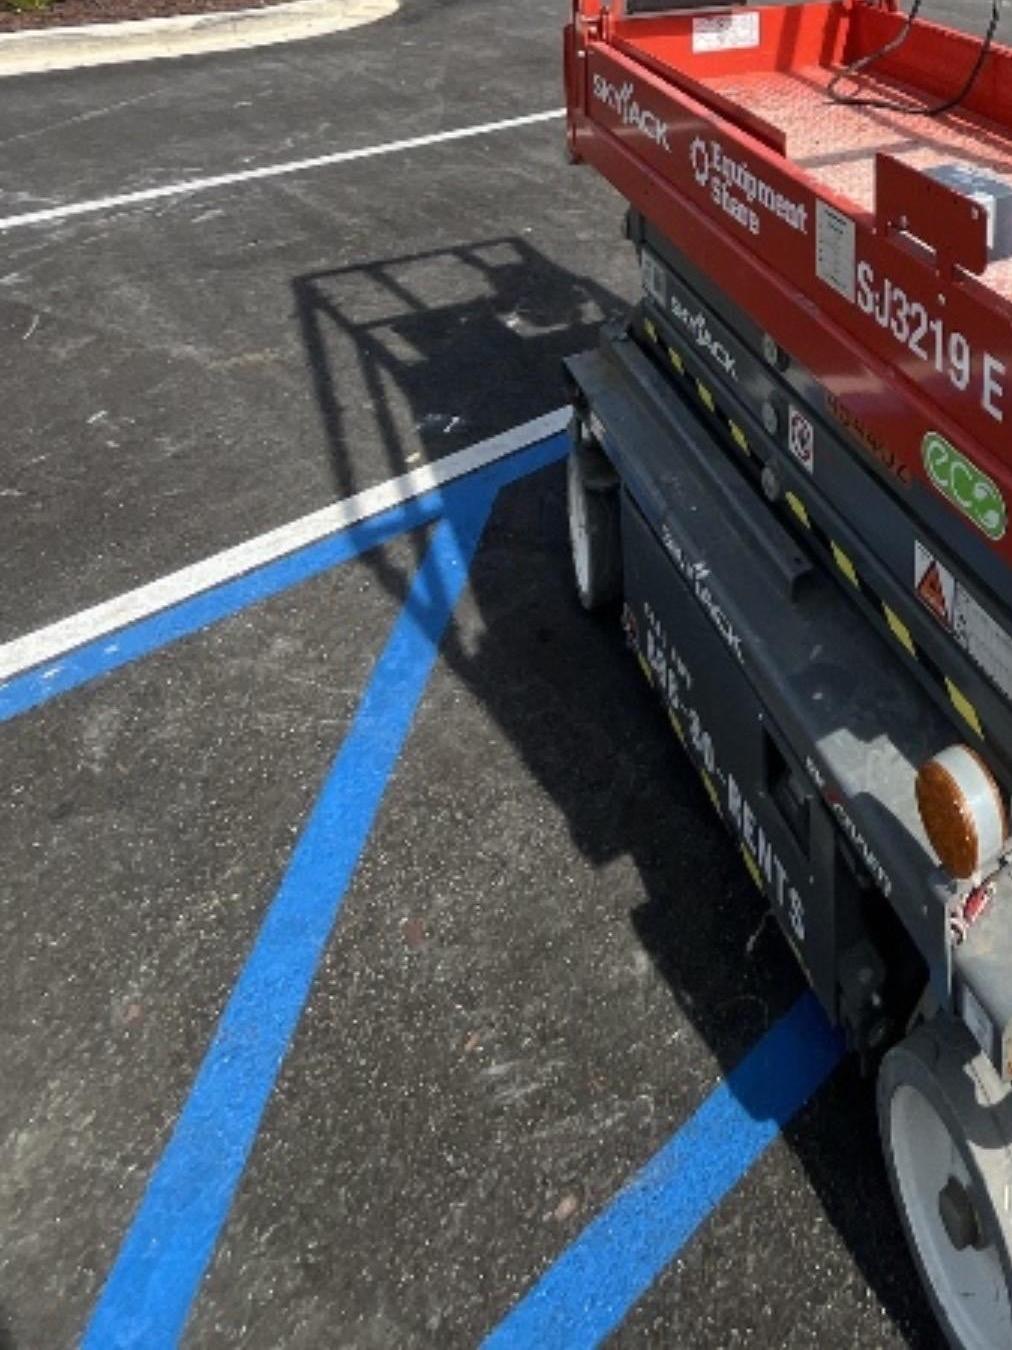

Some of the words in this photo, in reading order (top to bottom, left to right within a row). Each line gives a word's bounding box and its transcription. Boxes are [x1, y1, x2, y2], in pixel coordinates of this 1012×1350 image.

[593, 75, 671, 152] SKYJACK
[709, 140, 808, 233] Equipment
[710, 176, 760, 235] Share
[856, 260, 971, 392] SJ3219
[980, 351, 1007, 423] E
